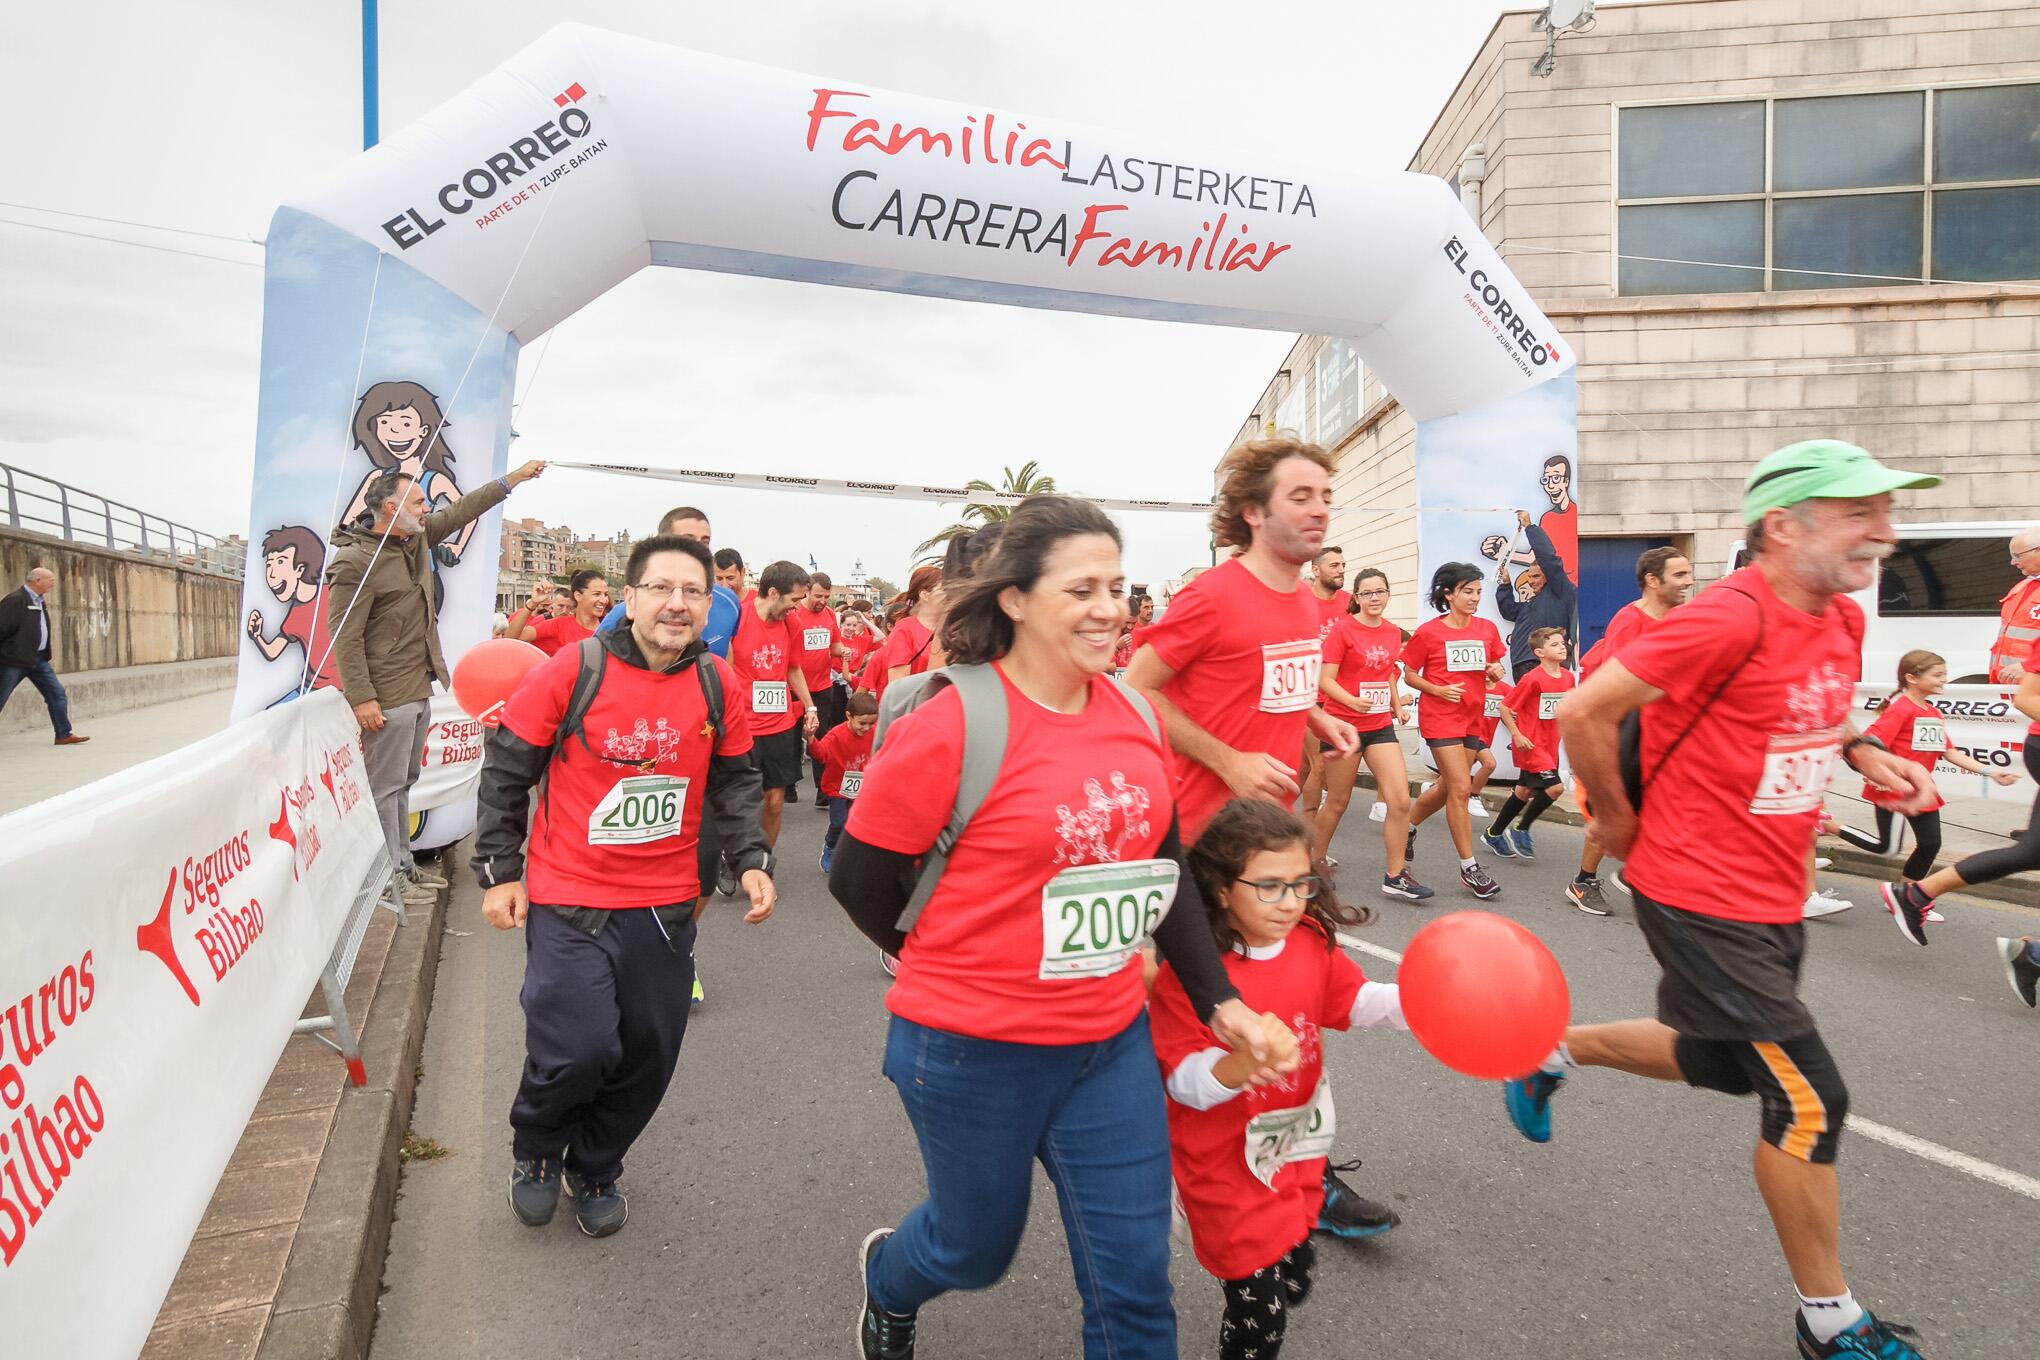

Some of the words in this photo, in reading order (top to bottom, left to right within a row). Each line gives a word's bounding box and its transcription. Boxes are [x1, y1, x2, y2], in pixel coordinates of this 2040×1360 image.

[381, 207, 447, 251] EL
[438, 107, 592, 215] CORREO
[475, 200, 513, 230] PARTE
[511, 190, 530, 207] DE
[527, 182, 542, 197] TI
[539, 164, 572, 188] ZURE
[569, 138, 608, 169] BAITAN
[1443, 235, 1469, 275] EL
[1470, 269, 1548, 366] CORREO
[1464, 293, 1484, 317] PARTE
[1481, 314, 1493, 328] DE
[1491, 324, 1499, 335] TI
[1496, 332, 1512, 354] ZURE
[1511, 351, 1533, 378] BAITAN
[807, 634, 828, 646] 2017
[1452, 648, 1484, 664] 2012
[1544, 699, 1558, 713] 20
[844, 779, 861, 792] 20
[182, 829, 251, 916] Seguros
[194, 897, 265, 983] Bilbao
[1061, 890, 1164, 954] 2006
